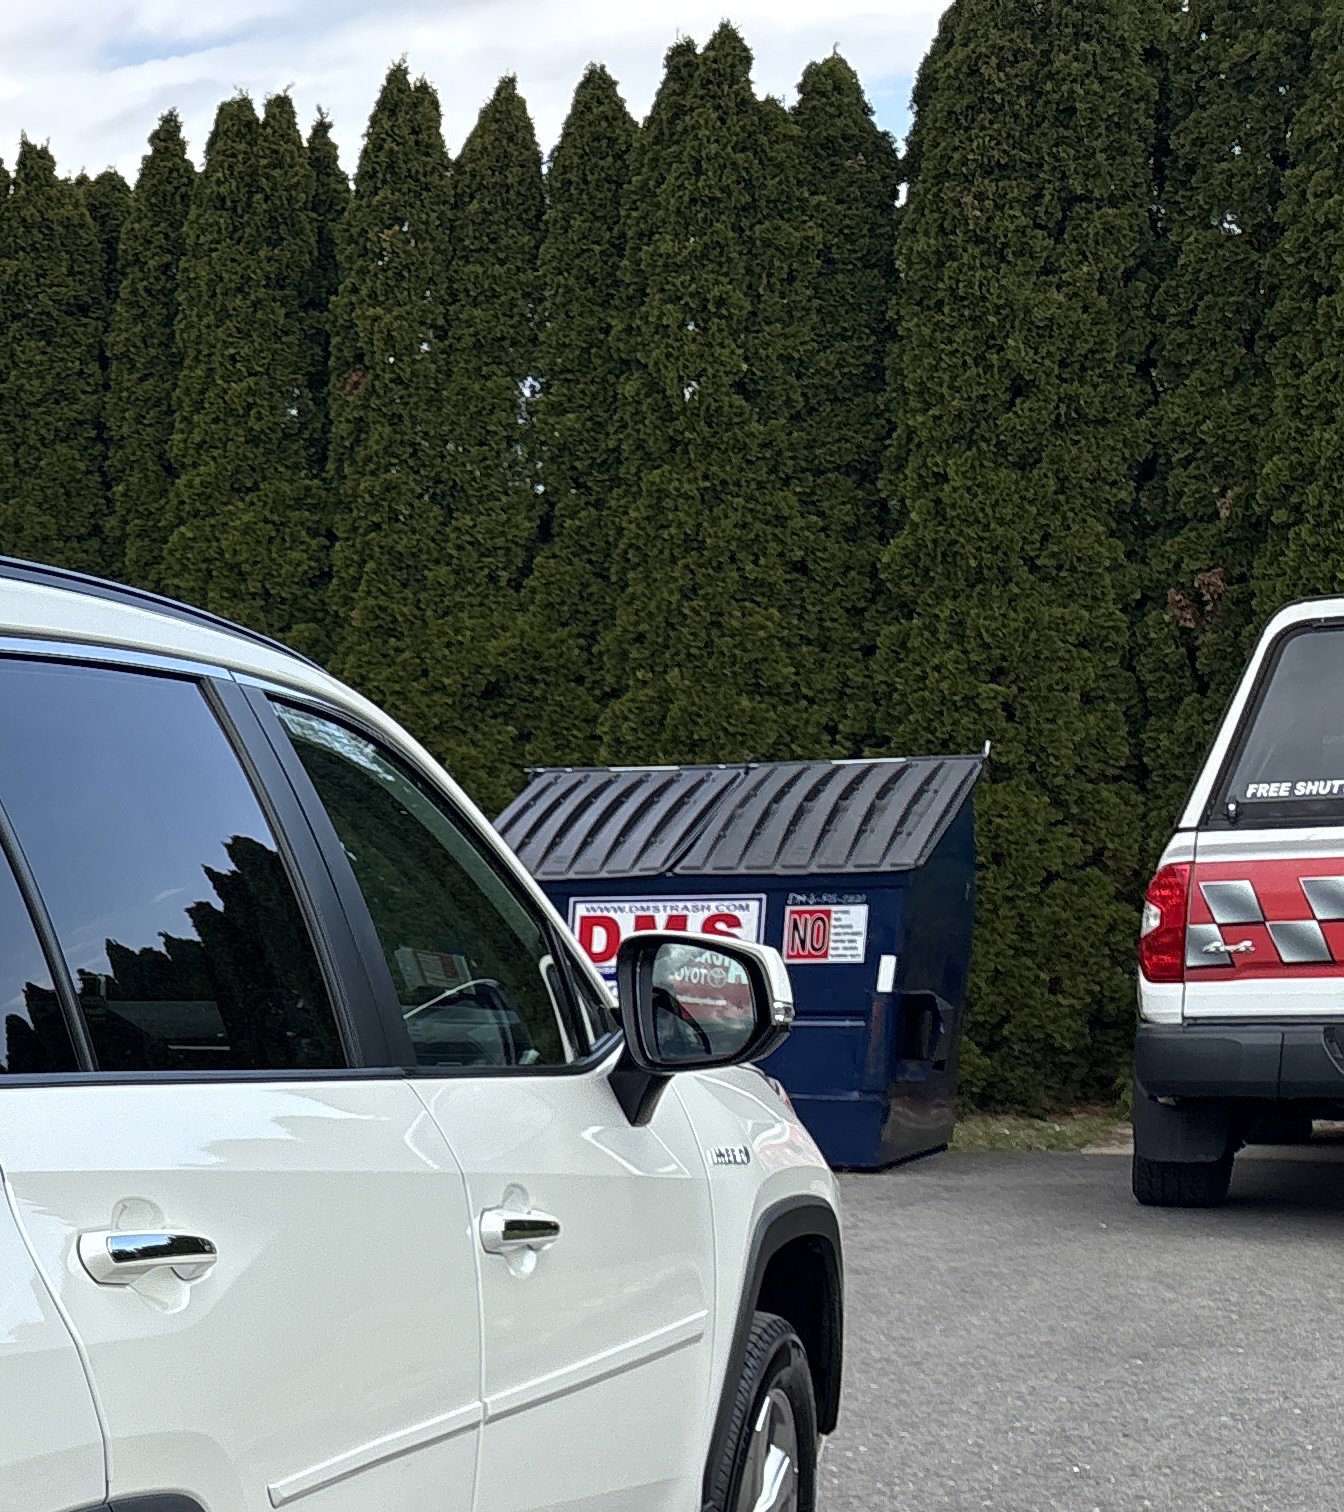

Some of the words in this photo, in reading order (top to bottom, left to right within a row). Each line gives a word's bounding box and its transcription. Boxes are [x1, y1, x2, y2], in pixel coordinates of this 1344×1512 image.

[1246, 781, 1292, 798] FREE
[1294, 779, 1344, 796] SHUT
[789, 912, 829, 955] NO
